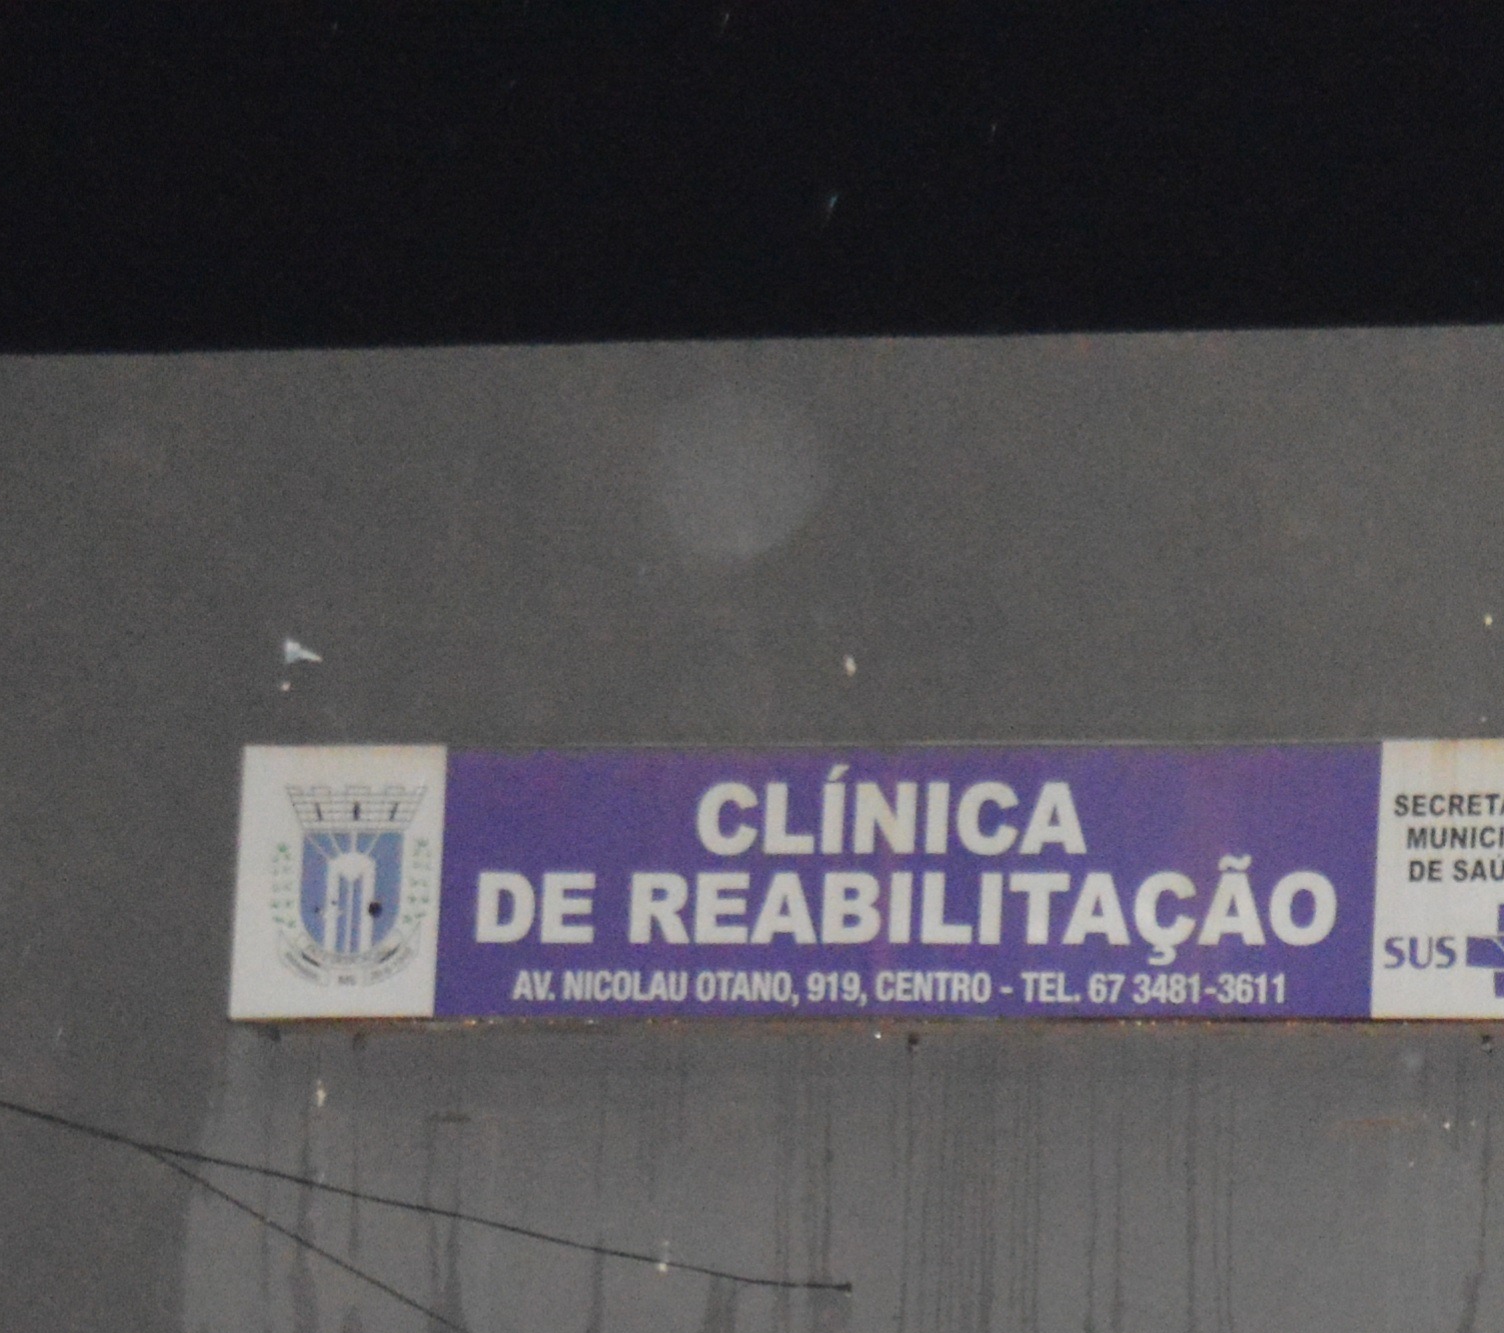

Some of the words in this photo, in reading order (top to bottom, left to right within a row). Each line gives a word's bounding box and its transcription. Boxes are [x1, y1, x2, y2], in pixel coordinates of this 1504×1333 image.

[697, 764, 1088, 856] CLÍNICA
[1408, 860, 1443, 882] DE
[475, 871, 596, 945] DE
[628, 854, 1338, 966] REABILITAÇÃO
[1383, 936, 1457, 970] SUS
[513, 970, 556, 1001] AV.
[563, 970, 688, 1002] NICOLAU
[697, 970, 800, 1006] OTANO,
[807, 971, 867, 1006] 919,
[876, 970, 993, 1003] CENTRO
[1021, 971, 1081, 1003] TEL.
[1088, 972, 1126, 1004] 67
[1132, 972, 1287, 1005] 3481-3611
